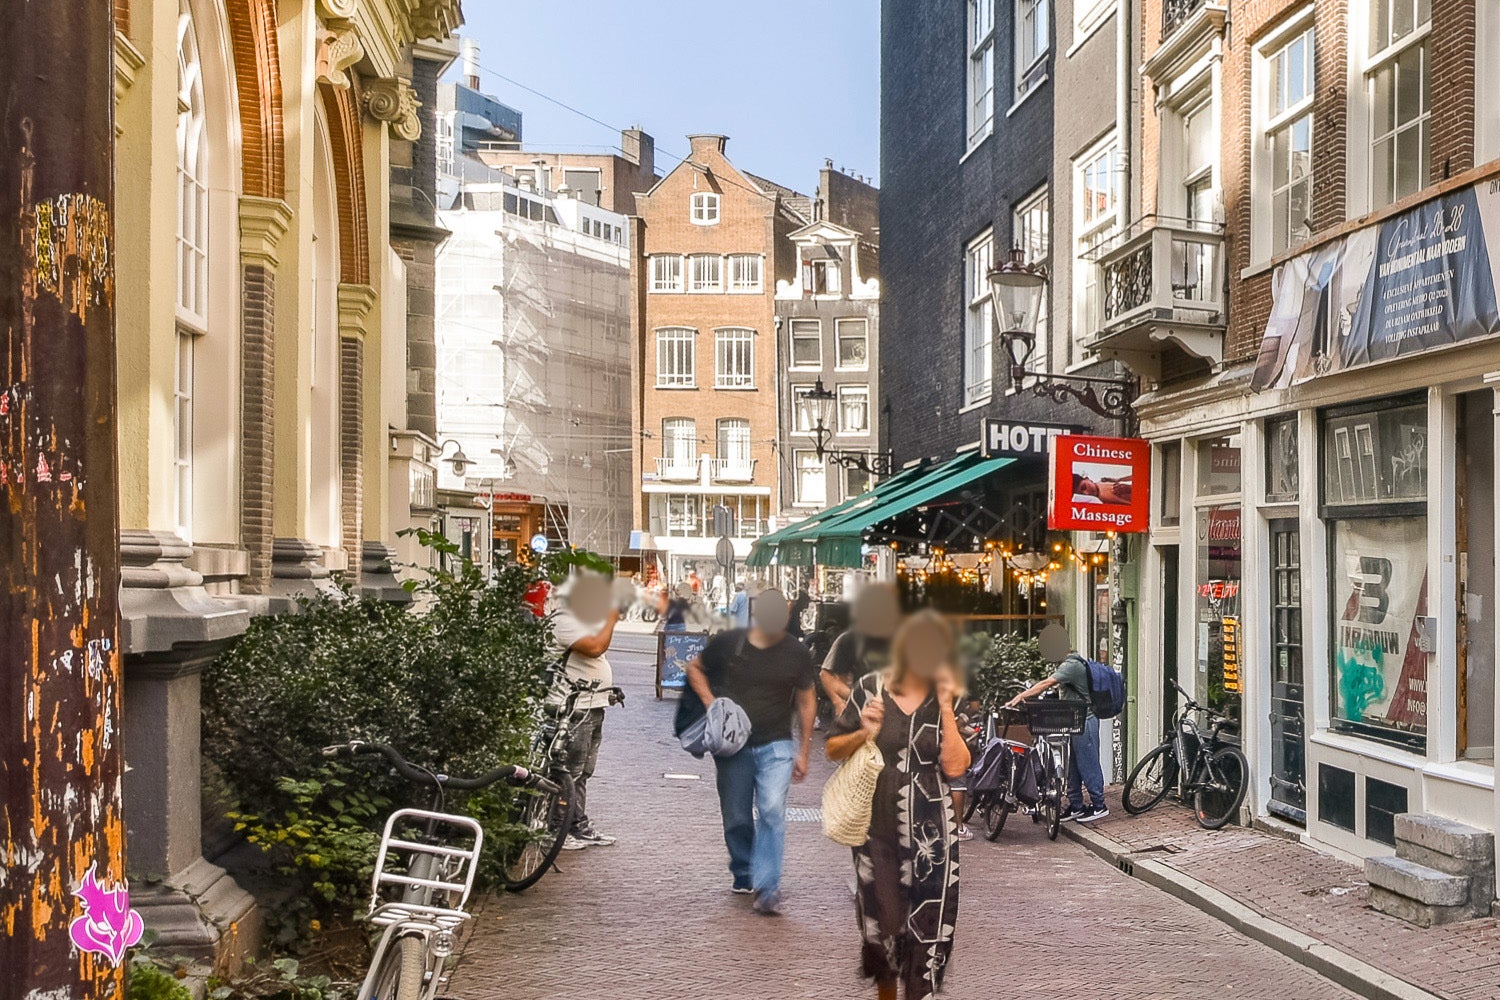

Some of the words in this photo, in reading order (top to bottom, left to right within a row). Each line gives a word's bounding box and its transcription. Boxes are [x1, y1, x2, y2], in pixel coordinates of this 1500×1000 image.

[990, 423, 1070, 453] HOT
[1073, 443, 1132, 460] Chinese
[1071, 507, 1132, 526] Massage
[1408, 677, 1427, 692] WWW.
[1407, 699, 1427, 715] INFO@
